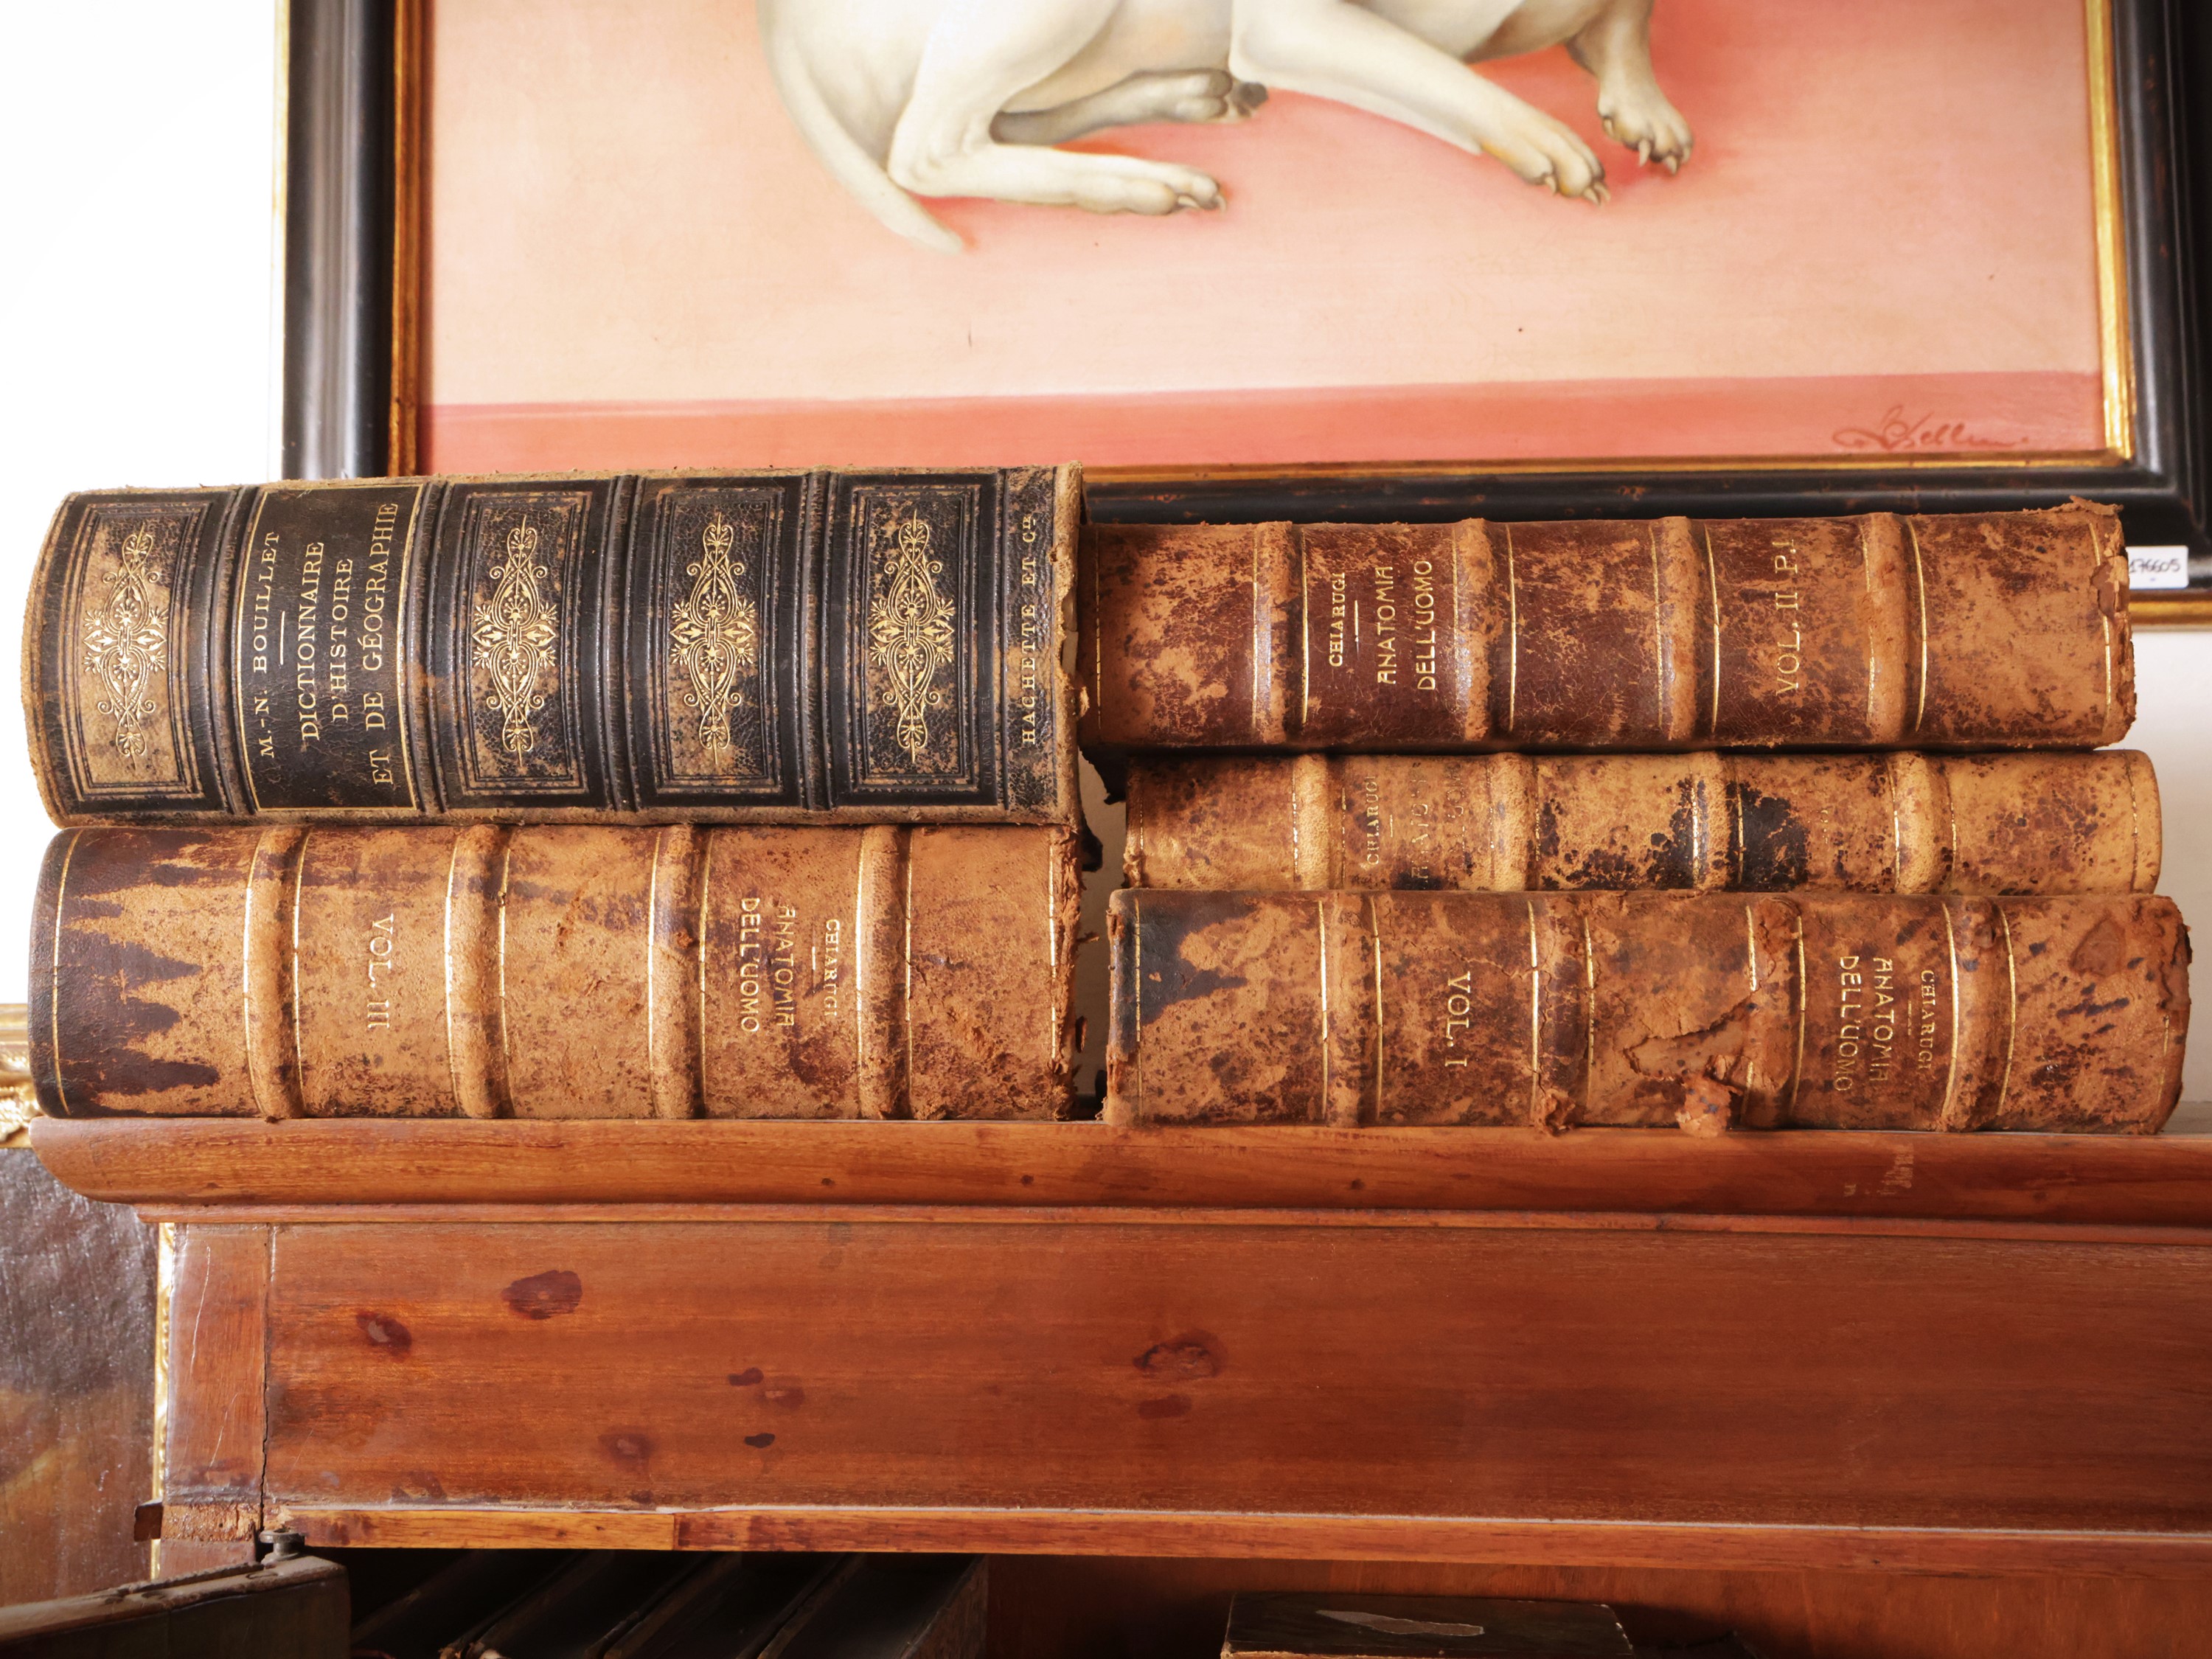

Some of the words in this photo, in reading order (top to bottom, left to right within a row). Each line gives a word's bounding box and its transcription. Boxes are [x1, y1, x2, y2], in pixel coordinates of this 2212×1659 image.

[254, 532, 279, 672] BOUILLET
[358, 503, 398, 671] GÉOGRAPHIE
[1021, 556, 1036, 586] ET
[1329, 572, 1346, 667] CHIARUGI
[1775, 592, 1798, 611] II
[298, 542, 324, 740] DICTIONNAIRE
[330, 559, 353, 721] D'HISTOIRE
[1021, 603, 1036, 745] HACHETTE
[1374, 566, 1397, 684] ANATOMIA
[1414, 560, 1436, 690] DELL'UOMO
[1774, 622, 1800, 696] VOL.
[255, 690, 274, 758] M.-N.
[364, 692, 386, 731] DE
[369, 749, 393, 785] ET
[368, 913, 394, 988] VOL.
[739, 897, 760, 1033] DELL'UOMO
[773, 905, 796, 1027] ANATOMIA
[823, 918, 841, 1017] CHIARUGI
[366, 999, 390, 1029] III
[1445, 970, 1471, 1048] VOL.
[1833, 955, 1862, 1091] DELL'UOMO
[1869, 957, 1894, 1081] ANATOMIA
[1917, 970, 1935, 1071] CHIARUGI
[1444, 1057, 1467, 1067] I
